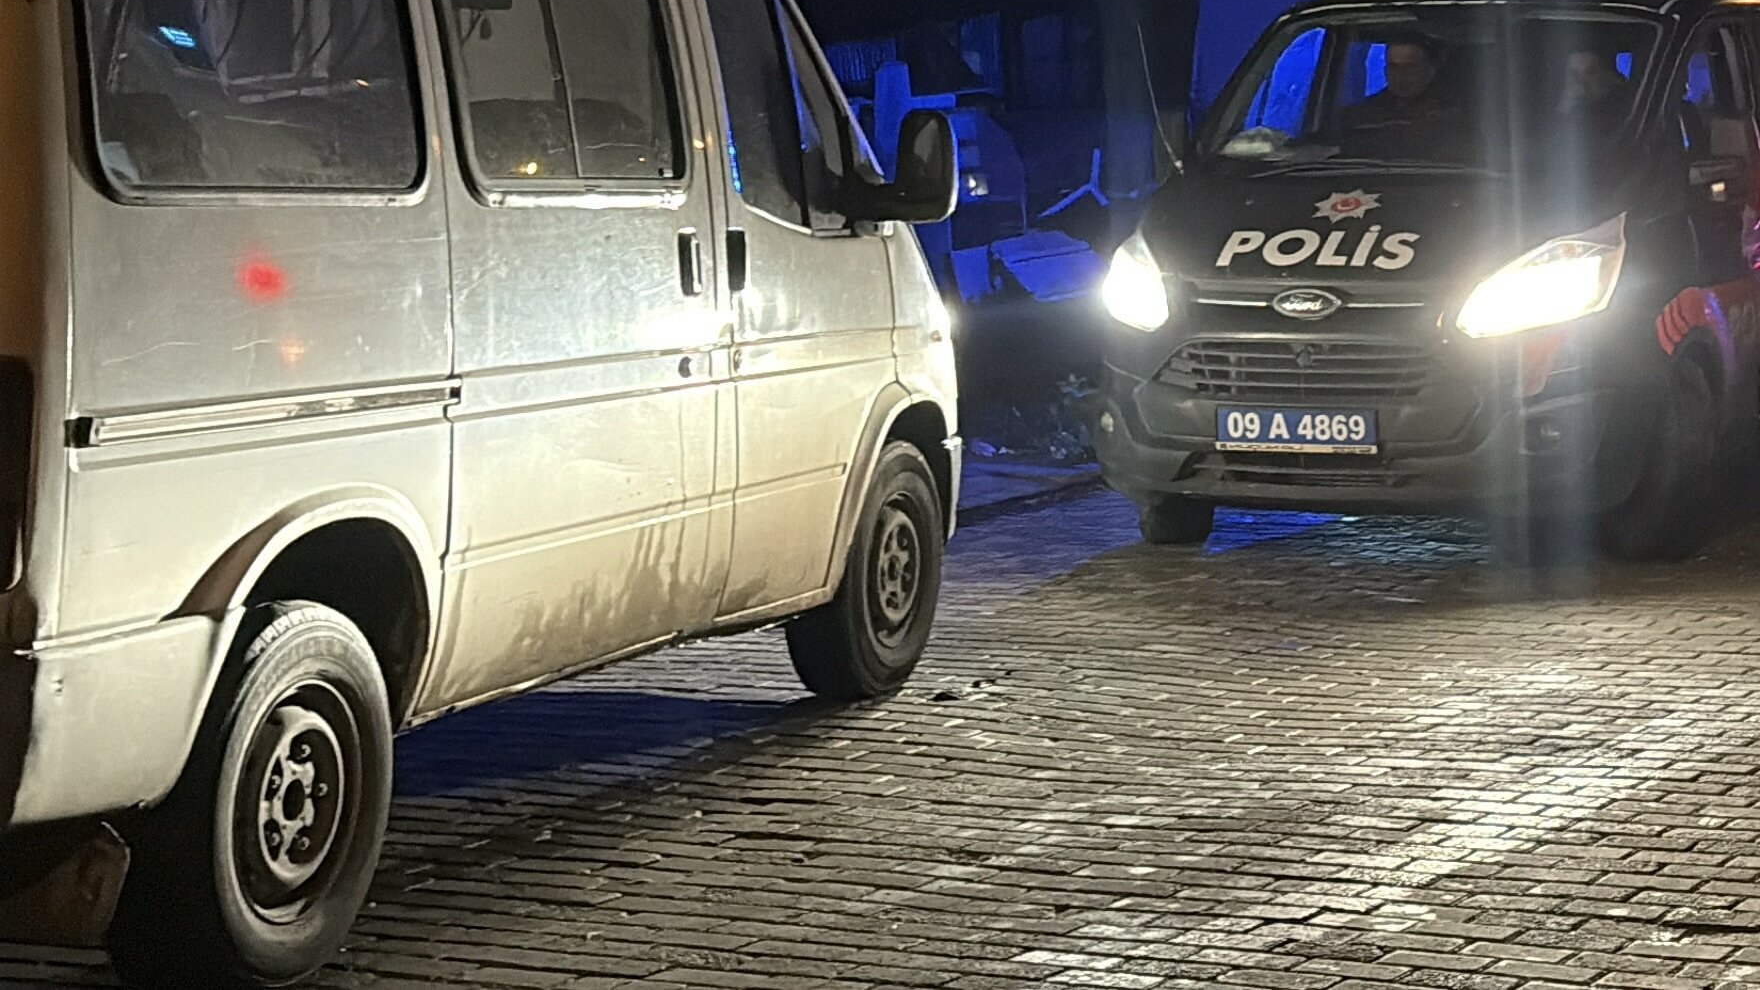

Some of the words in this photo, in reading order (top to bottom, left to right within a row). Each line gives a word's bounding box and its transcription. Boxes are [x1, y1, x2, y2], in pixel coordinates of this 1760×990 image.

[1216, 224, 1420, 270] POLİS
[1227, 412, 1261, 439] 09
[1268, 412, 1291, 440] A
[1296, 414, 1366, 441] 4869
